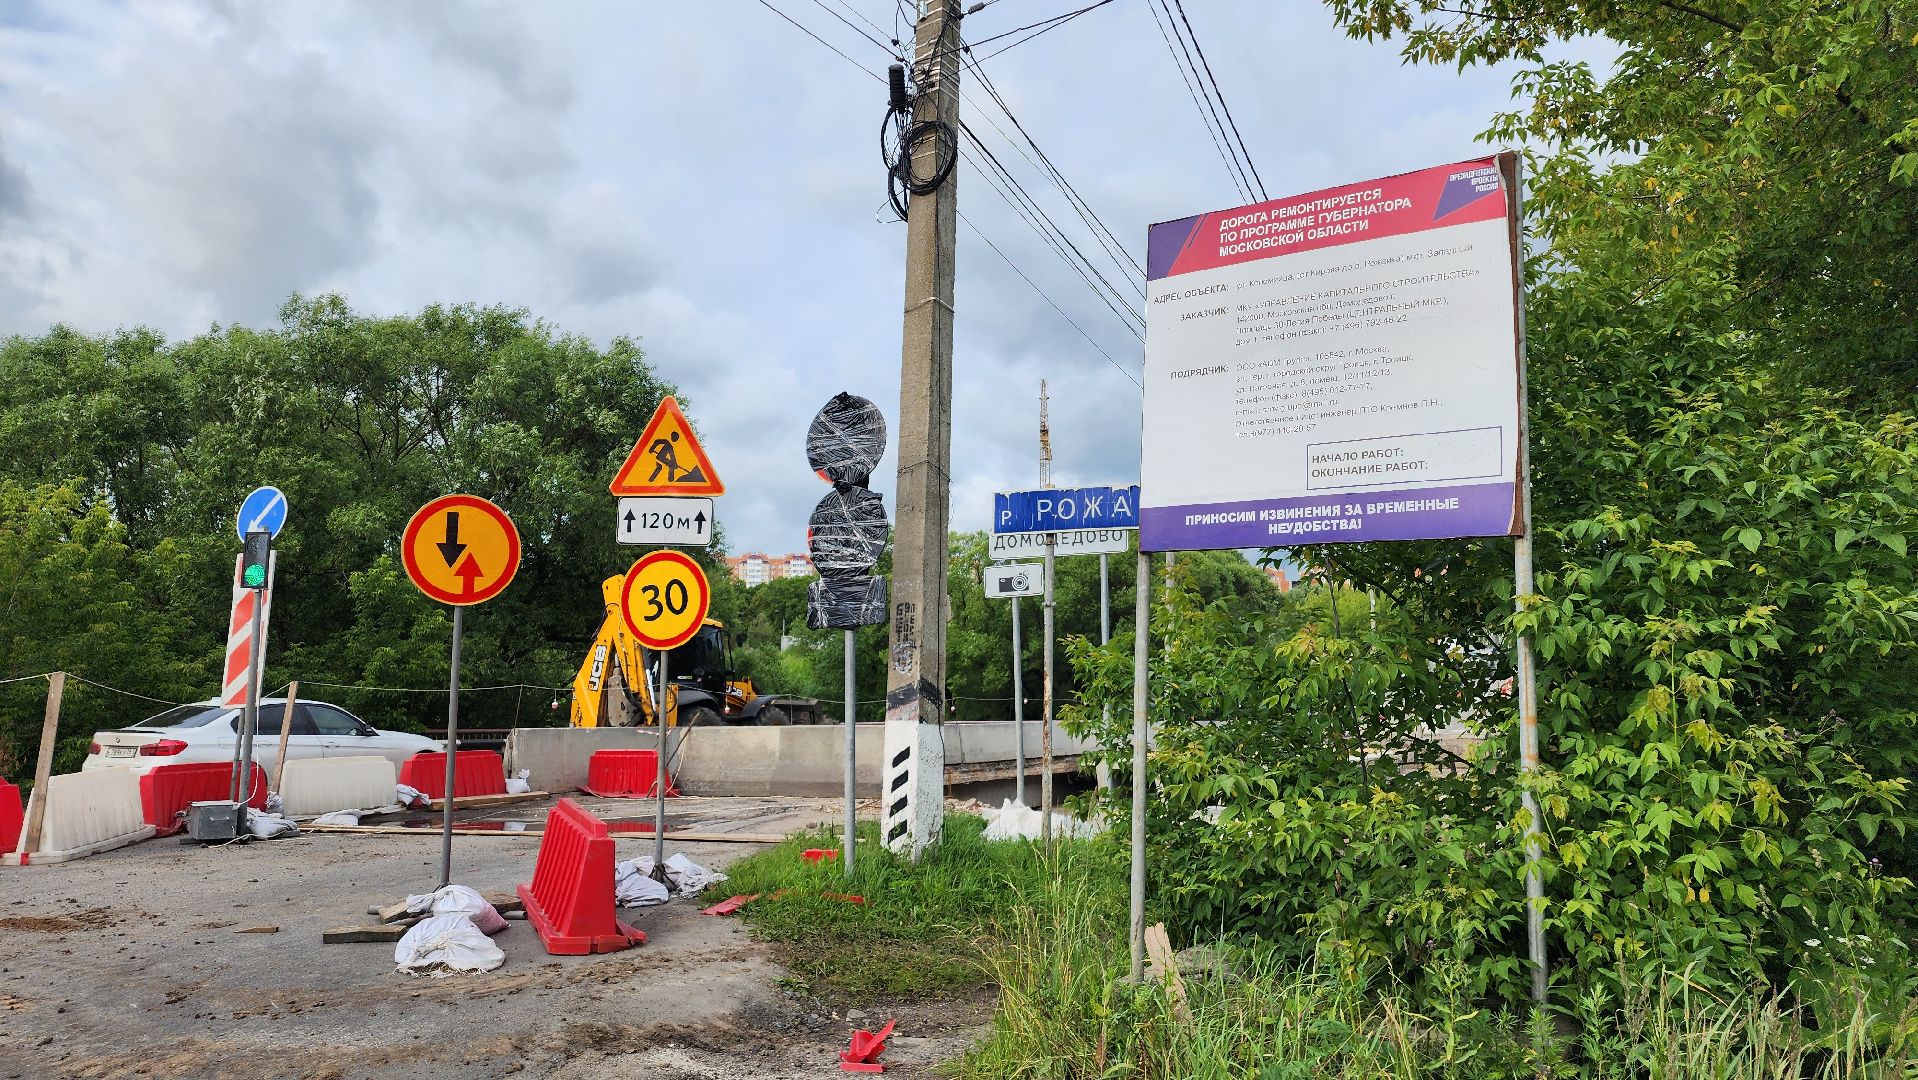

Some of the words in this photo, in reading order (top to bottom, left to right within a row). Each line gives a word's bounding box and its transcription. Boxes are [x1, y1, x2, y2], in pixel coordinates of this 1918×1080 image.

[1220, 210, 1267, 231] ДОРОГА
[1271, 188, 1381, 220] РЕМОНТИРУЕТСЯ
[1220, 231, 1236, 243] ПО
[1240, 215, 1314, 239] ПРОГРАММЕ
[1318, 196, 1411, 224] ГУБЕРНАТОРА
[1219, 229, 1302, 256] МОСКОВСКОЙ
[1308, 218, 1368, 240] ОБЛАСТИ
[1154, 291, 1181, 304] АДРЕС
[1184, 283, 1228, 298] ОБЪЕКТА:
[1180, 306, 1228, 321] ЗАКАЗЧИК:
[1170, 364, 1228, 380] ПОДРЯДЧИК:
[1312, 451, 1357, 463] НАЧАЛО
[1362, 447, 1403, 459] РАБОТ:
[1312, 464, 1381, 477] ОКОНЧАНИЕ
[1386, 460, 1427, 472] РАБОТ:
[1185, 510, 1255, 525] ПРИНОСИМ
[1260, 505, 1340, 521] ИЗВИНЕНИЯ
[1344, 503, 1362, 515] ЗА
[1367, 496, 1458, 514] ВРЕМЕННЫЕ
[1268, 518, 1361, 535] НЕУДОБСТВА!
[642, 578, 688, 622] 30
[588, 645, 607, 690] JCB
